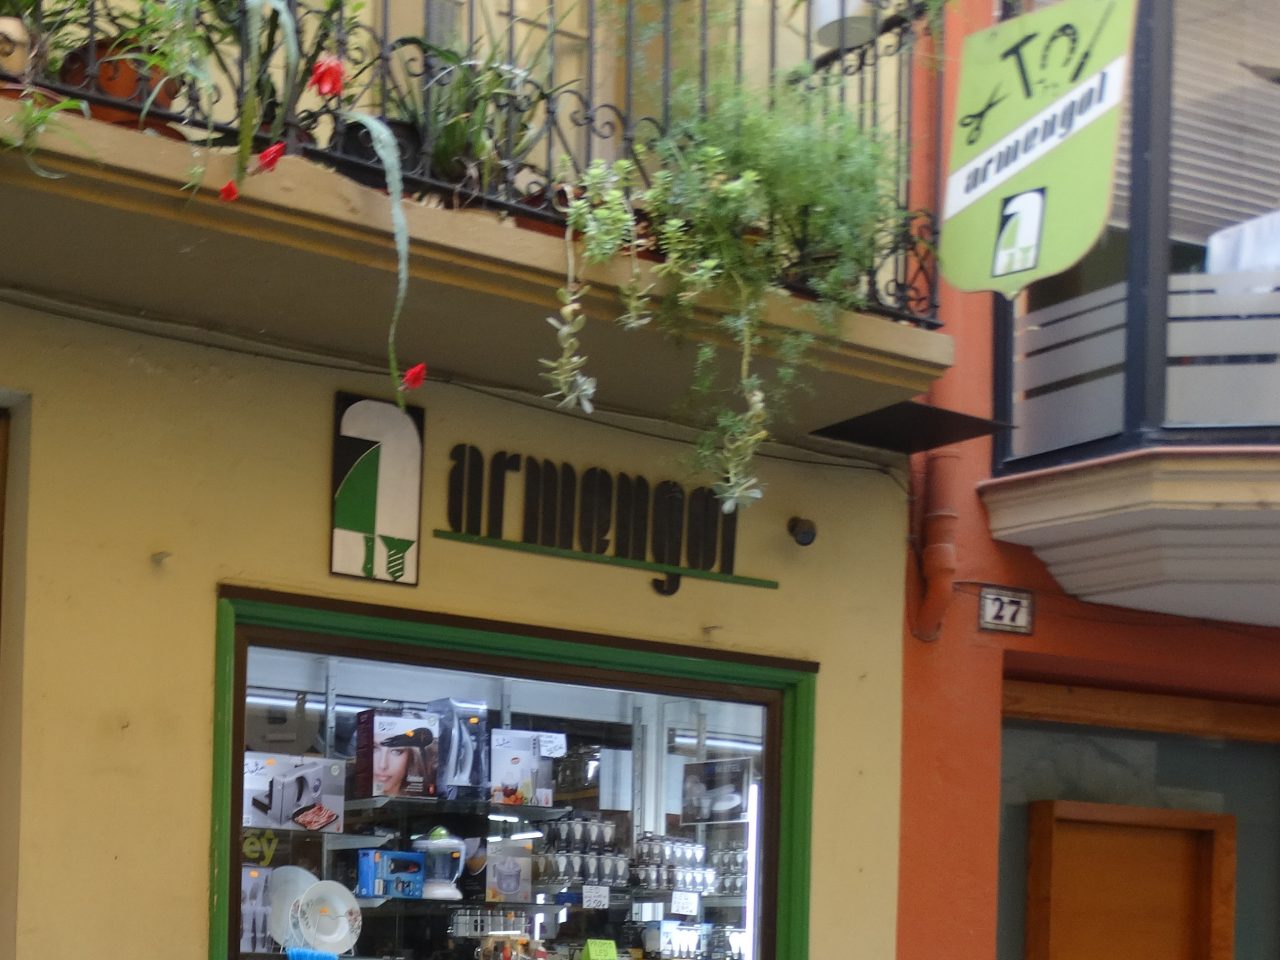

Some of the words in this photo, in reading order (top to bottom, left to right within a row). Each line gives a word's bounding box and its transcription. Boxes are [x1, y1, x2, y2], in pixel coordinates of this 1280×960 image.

[965, 71, 1107, 194] armengol
[447, 443, 737, 596] armengol
[992, 597, 1022, 623] 27
